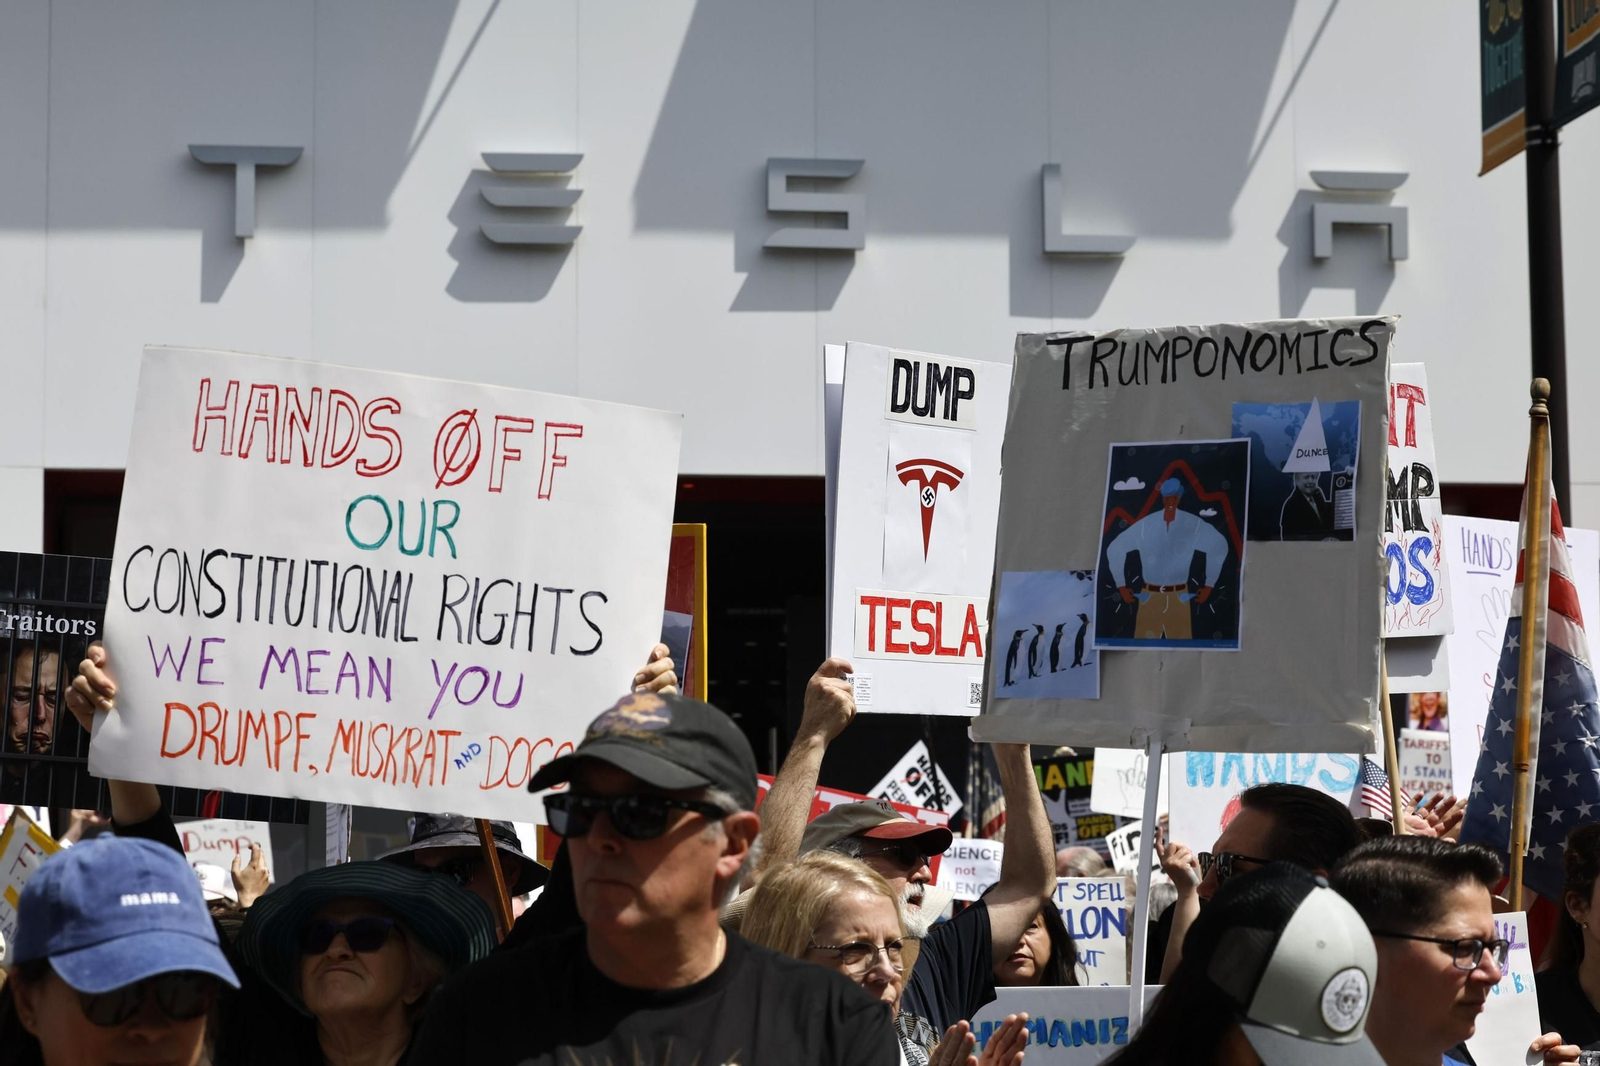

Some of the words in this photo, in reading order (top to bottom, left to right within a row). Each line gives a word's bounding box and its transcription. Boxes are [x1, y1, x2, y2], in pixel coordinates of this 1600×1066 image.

[188, 144, 1409, 261] TESLA
[1045, 319, 1388, 391] TRUMPONOMICS
[891, 357, 976, 423] DUMP
[192, 377, 402, 477] HANDS
[1295, 447, 1329, 459] DUNCE
[345, 494, 460, 558] OUR
[1460, 526, 1513, 572] HANDS
[123, 545, 419, 642] CONSTITUTIONAL
[437, 574, 608, 657] RIGHTS
[860, 595, 984, 658] TESLA
[147, 635, 226, 686] WE
[259, 645, 393, 703] MEAN
[427, 659, 524, 720] YOU
[160, 703, 319, 777] DRUMPF,
[326, 718, 462, 789] MUSKRAT
[453, 742, 482, 770] AND
[1403, 738, 1450, 751] TARIFFS
[1426, 753, 1442, 765] TO
[183, 830, 252, 854] Dump
[942, 847, 1001, 861] CIENCE
[955, 866, 976, 876] not
[1072, 882, 1125, 901] SPELL
[120, 891, 181, 907] mama
